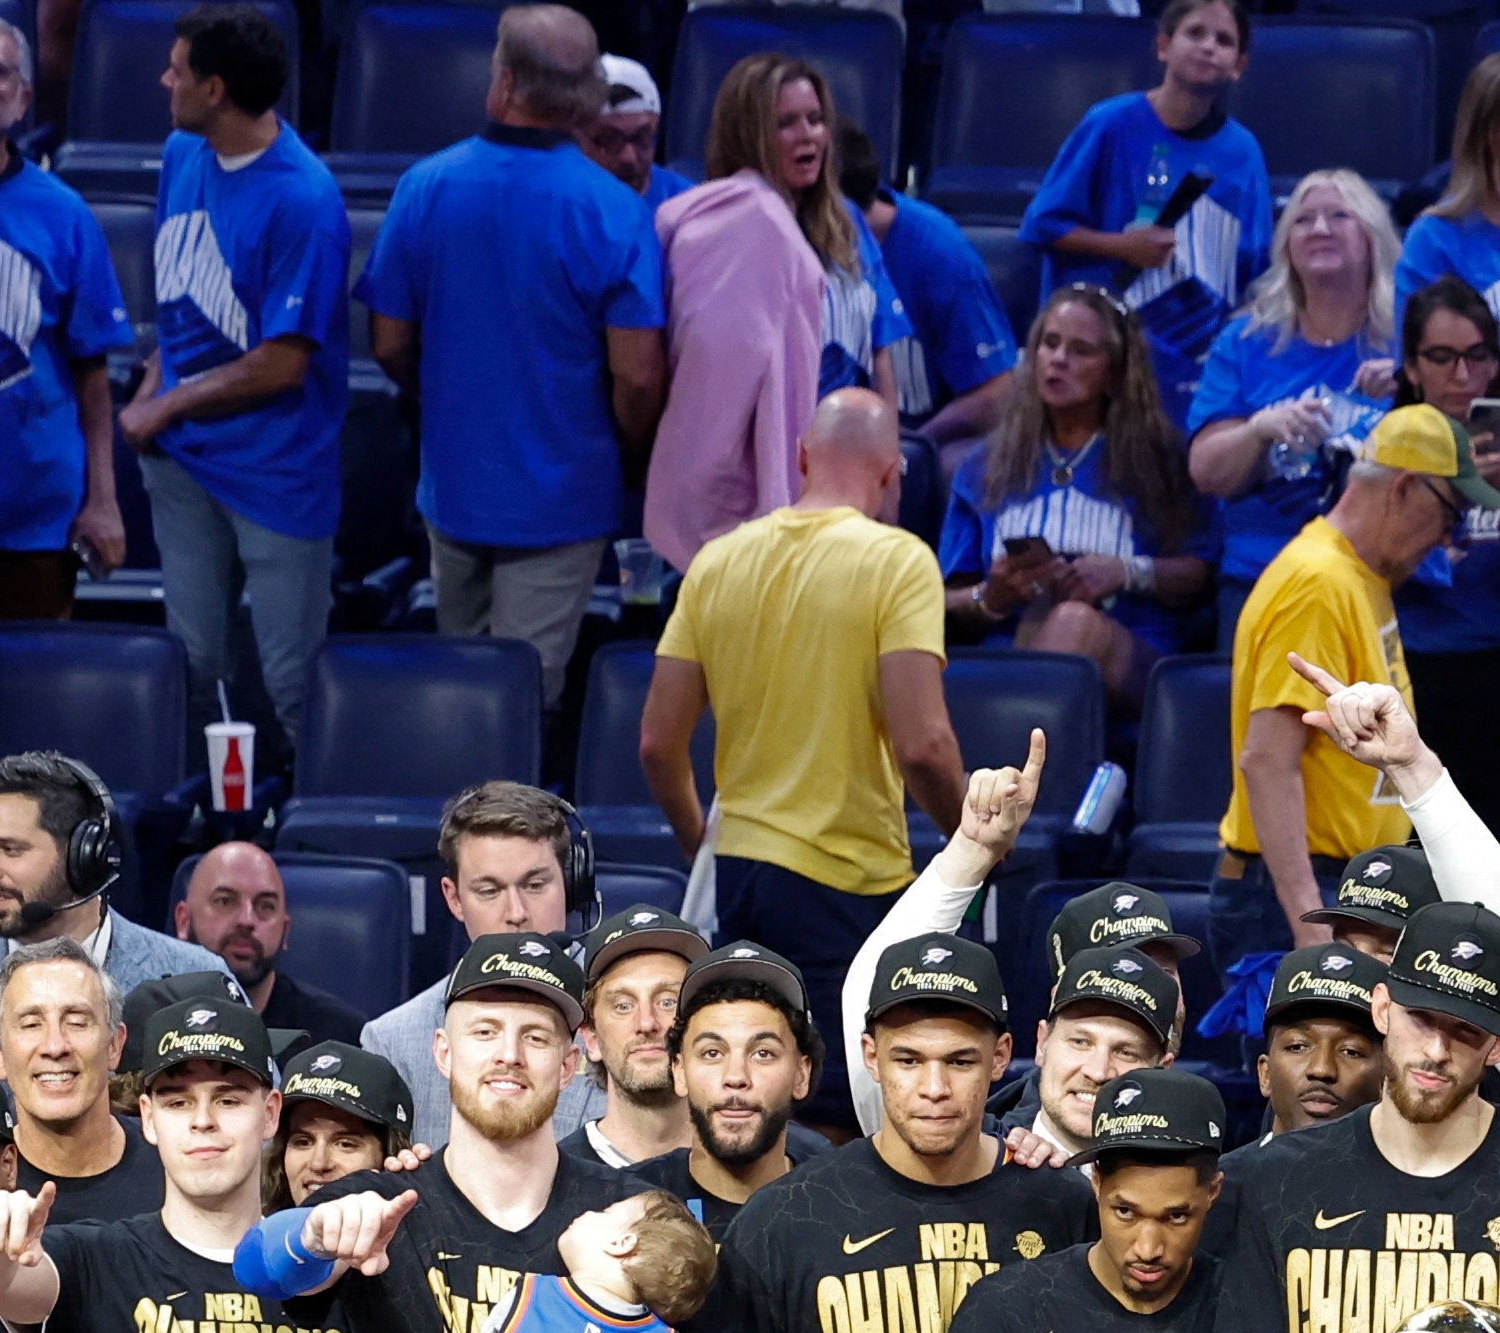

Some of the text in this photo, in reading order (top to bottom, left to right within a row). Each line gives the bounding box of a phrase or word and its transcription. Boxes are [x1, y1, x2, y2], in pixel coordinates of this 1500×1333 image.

[1338, 879, 1408, 909] Champions
[1089, 912, 1169, 944] Champions
[891, 968, 977, 992] Champions
[1288, 971, 1372, 1001] Champions
[1414, 950, 1497, 996] Champions
[1076, 970, 1156, 1009] Champions
[158, 1031, 244, 1054] Champions
[285, 1073, 361, 1098] Champions
[1095, 1112, 1169, 1139] Champions
[918, 1223, 987, 1260] NBA
[1385, 1213, 1454, 1251] NBA
[205, 1294, 261, 1320] NBA
